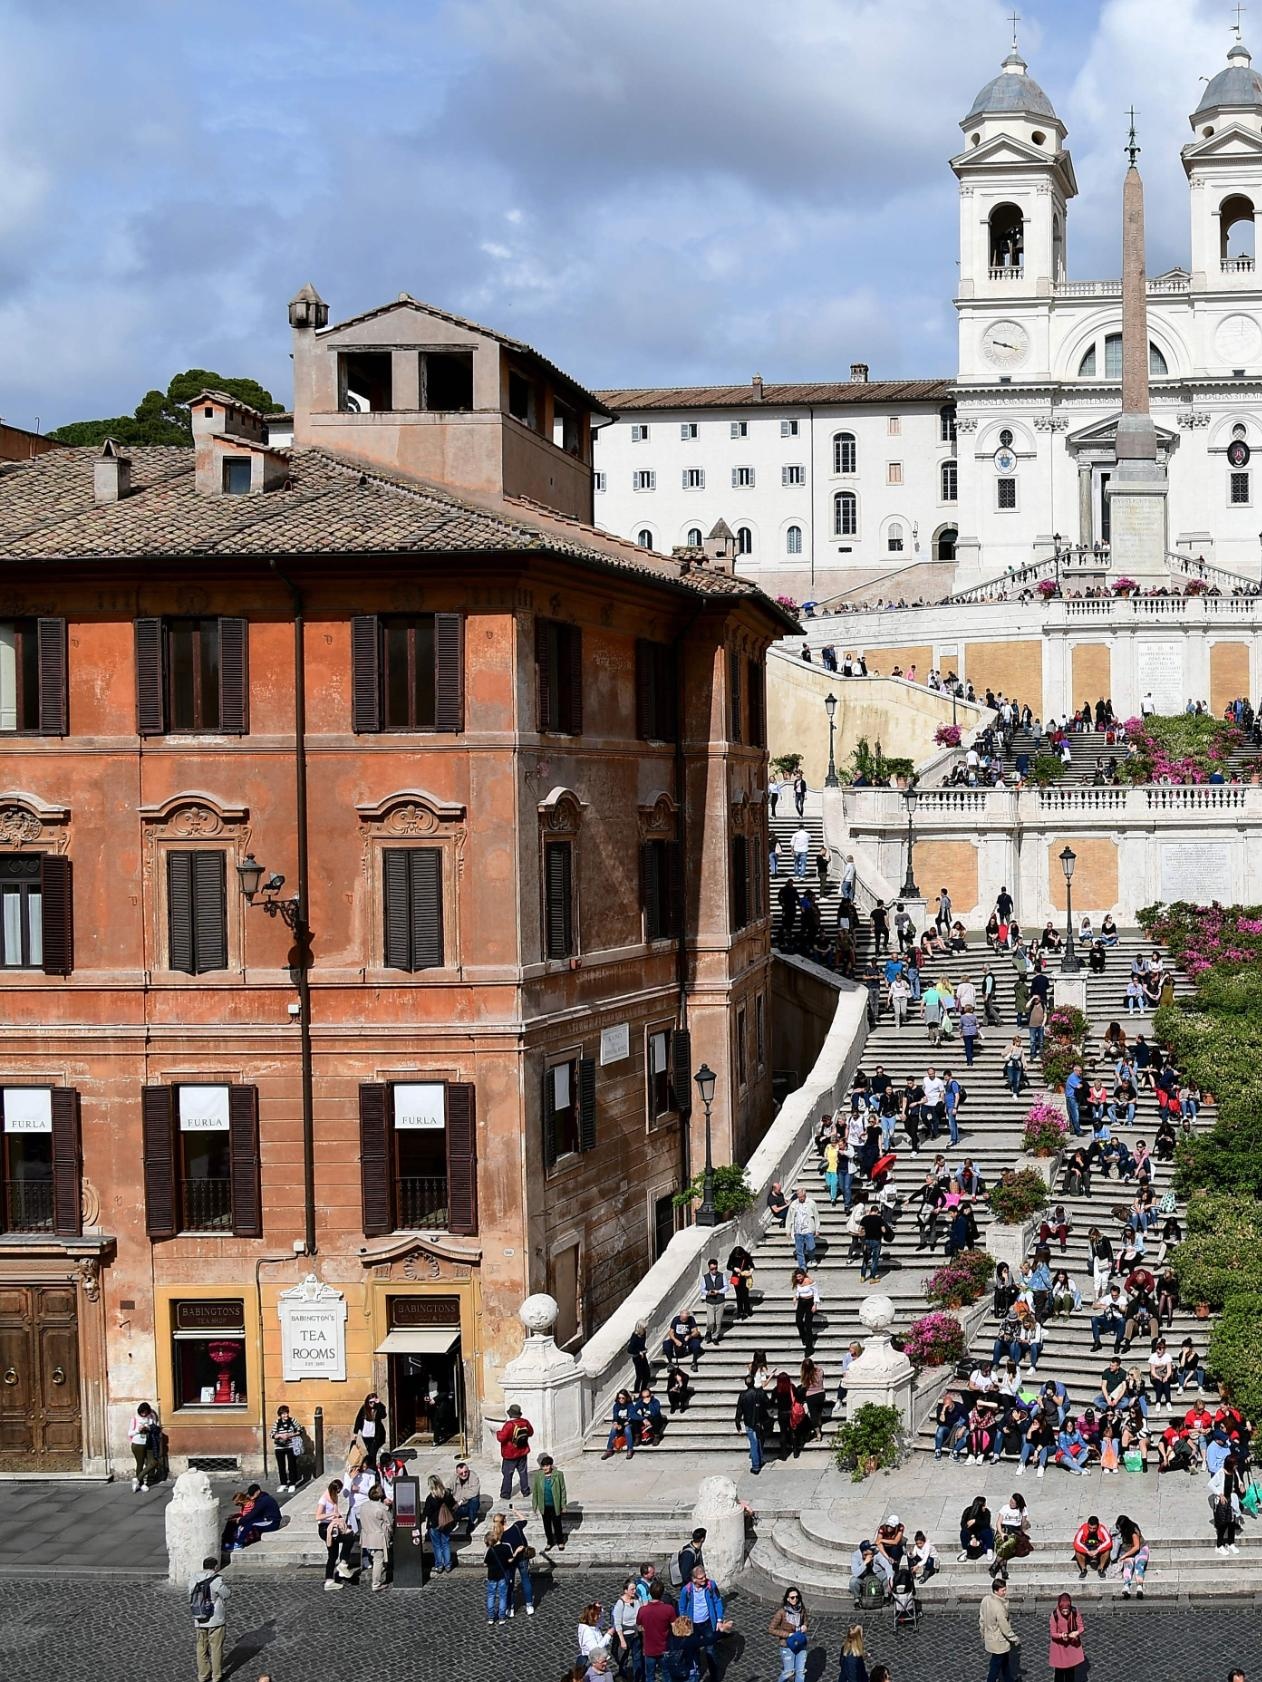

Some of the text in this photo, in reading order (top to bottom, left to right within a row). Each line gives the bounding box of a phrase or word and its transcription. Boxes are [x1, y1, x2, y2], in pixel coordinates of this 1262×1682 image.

[11, 1120, 46, 1128] FURLA
[187, 1118, 222, 1127] FURLA
[401, 1116, 437, 1125] FURLA
[300, 1330, 327, 1341] TEA
[292, 1348, 336, 1359] ROOMS
